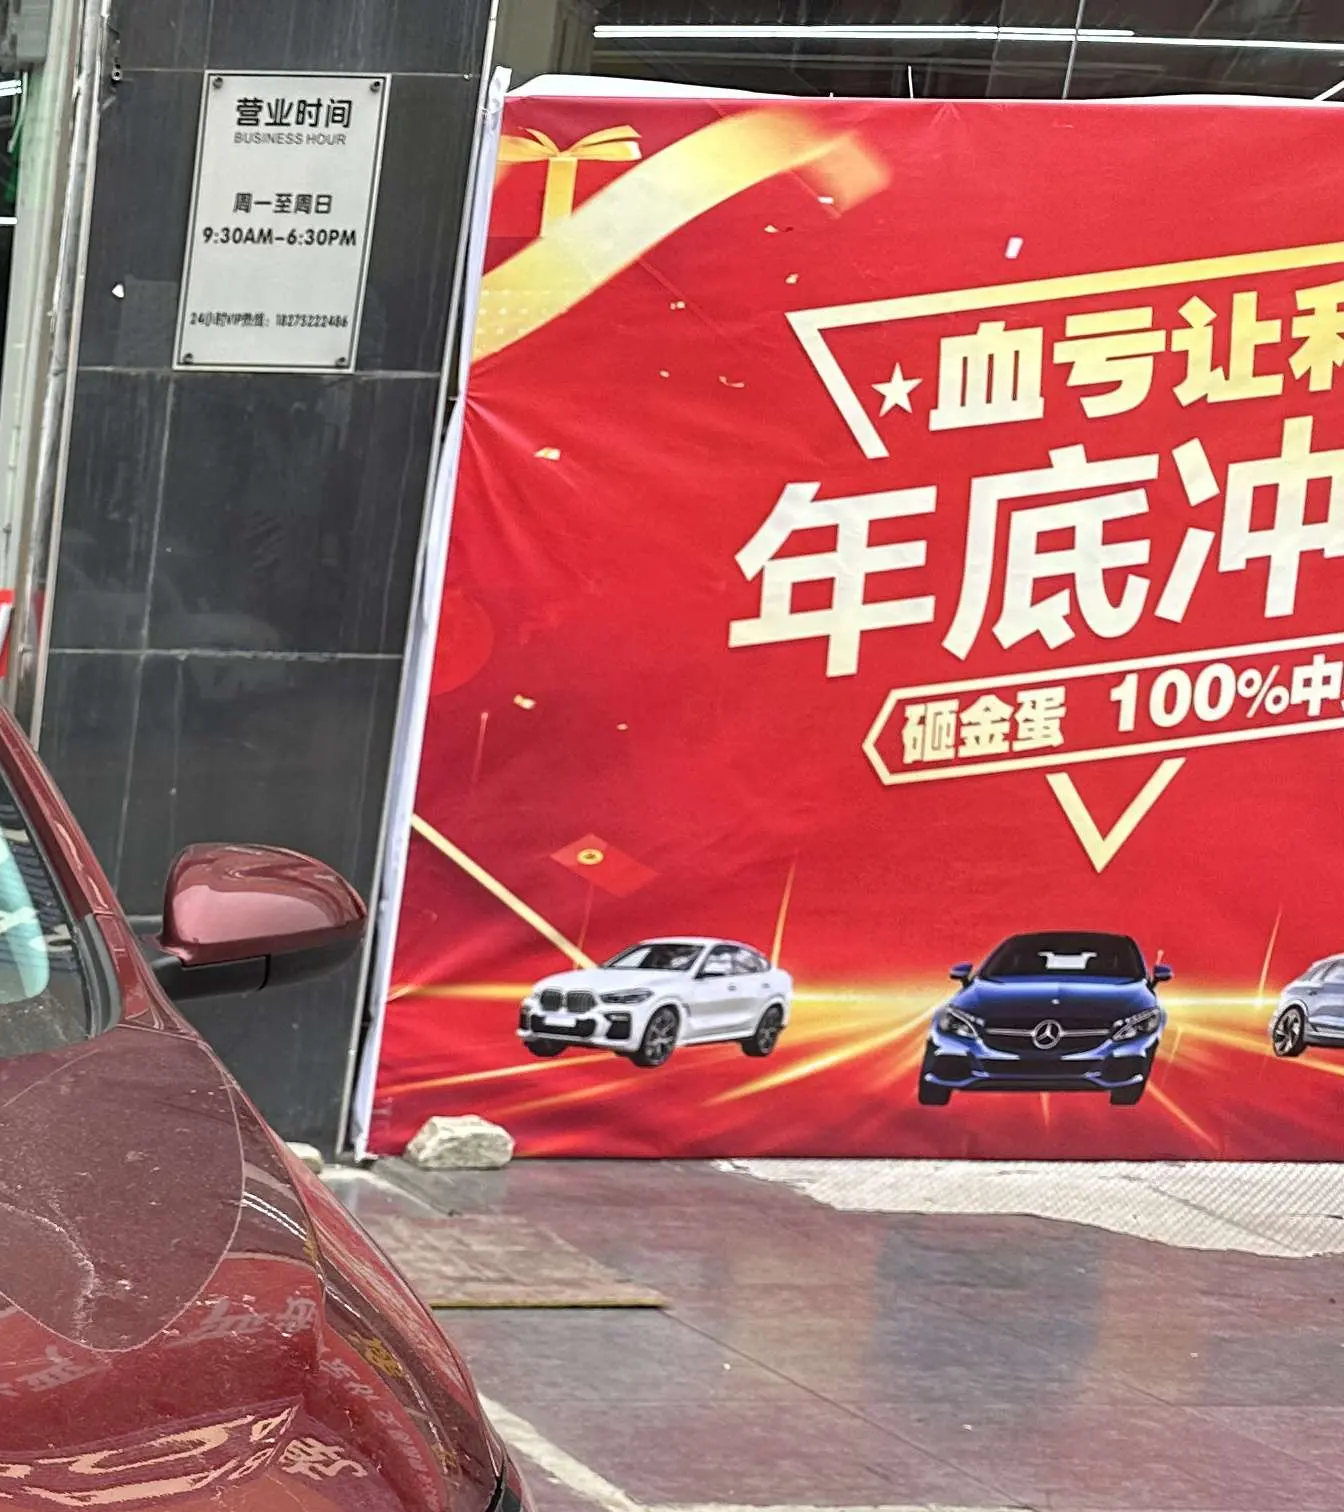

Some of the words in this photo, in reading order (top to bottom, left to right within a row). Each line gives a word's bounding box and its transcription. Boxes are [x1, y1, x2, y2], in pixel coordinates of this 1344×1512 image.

[235, 98, 353, 129] 营业时间
[233, 132, 304, 145] BUSINESS
[306, 133, 347, 146] HOUR
[232, 193, 333, 215] 周一至周日
[202, 227, 357, 247] 9:30AM-6:30PM
[727, 416, 1344, 678] 年底冲
[901, 685, 1067, 765] 砸金蛋
